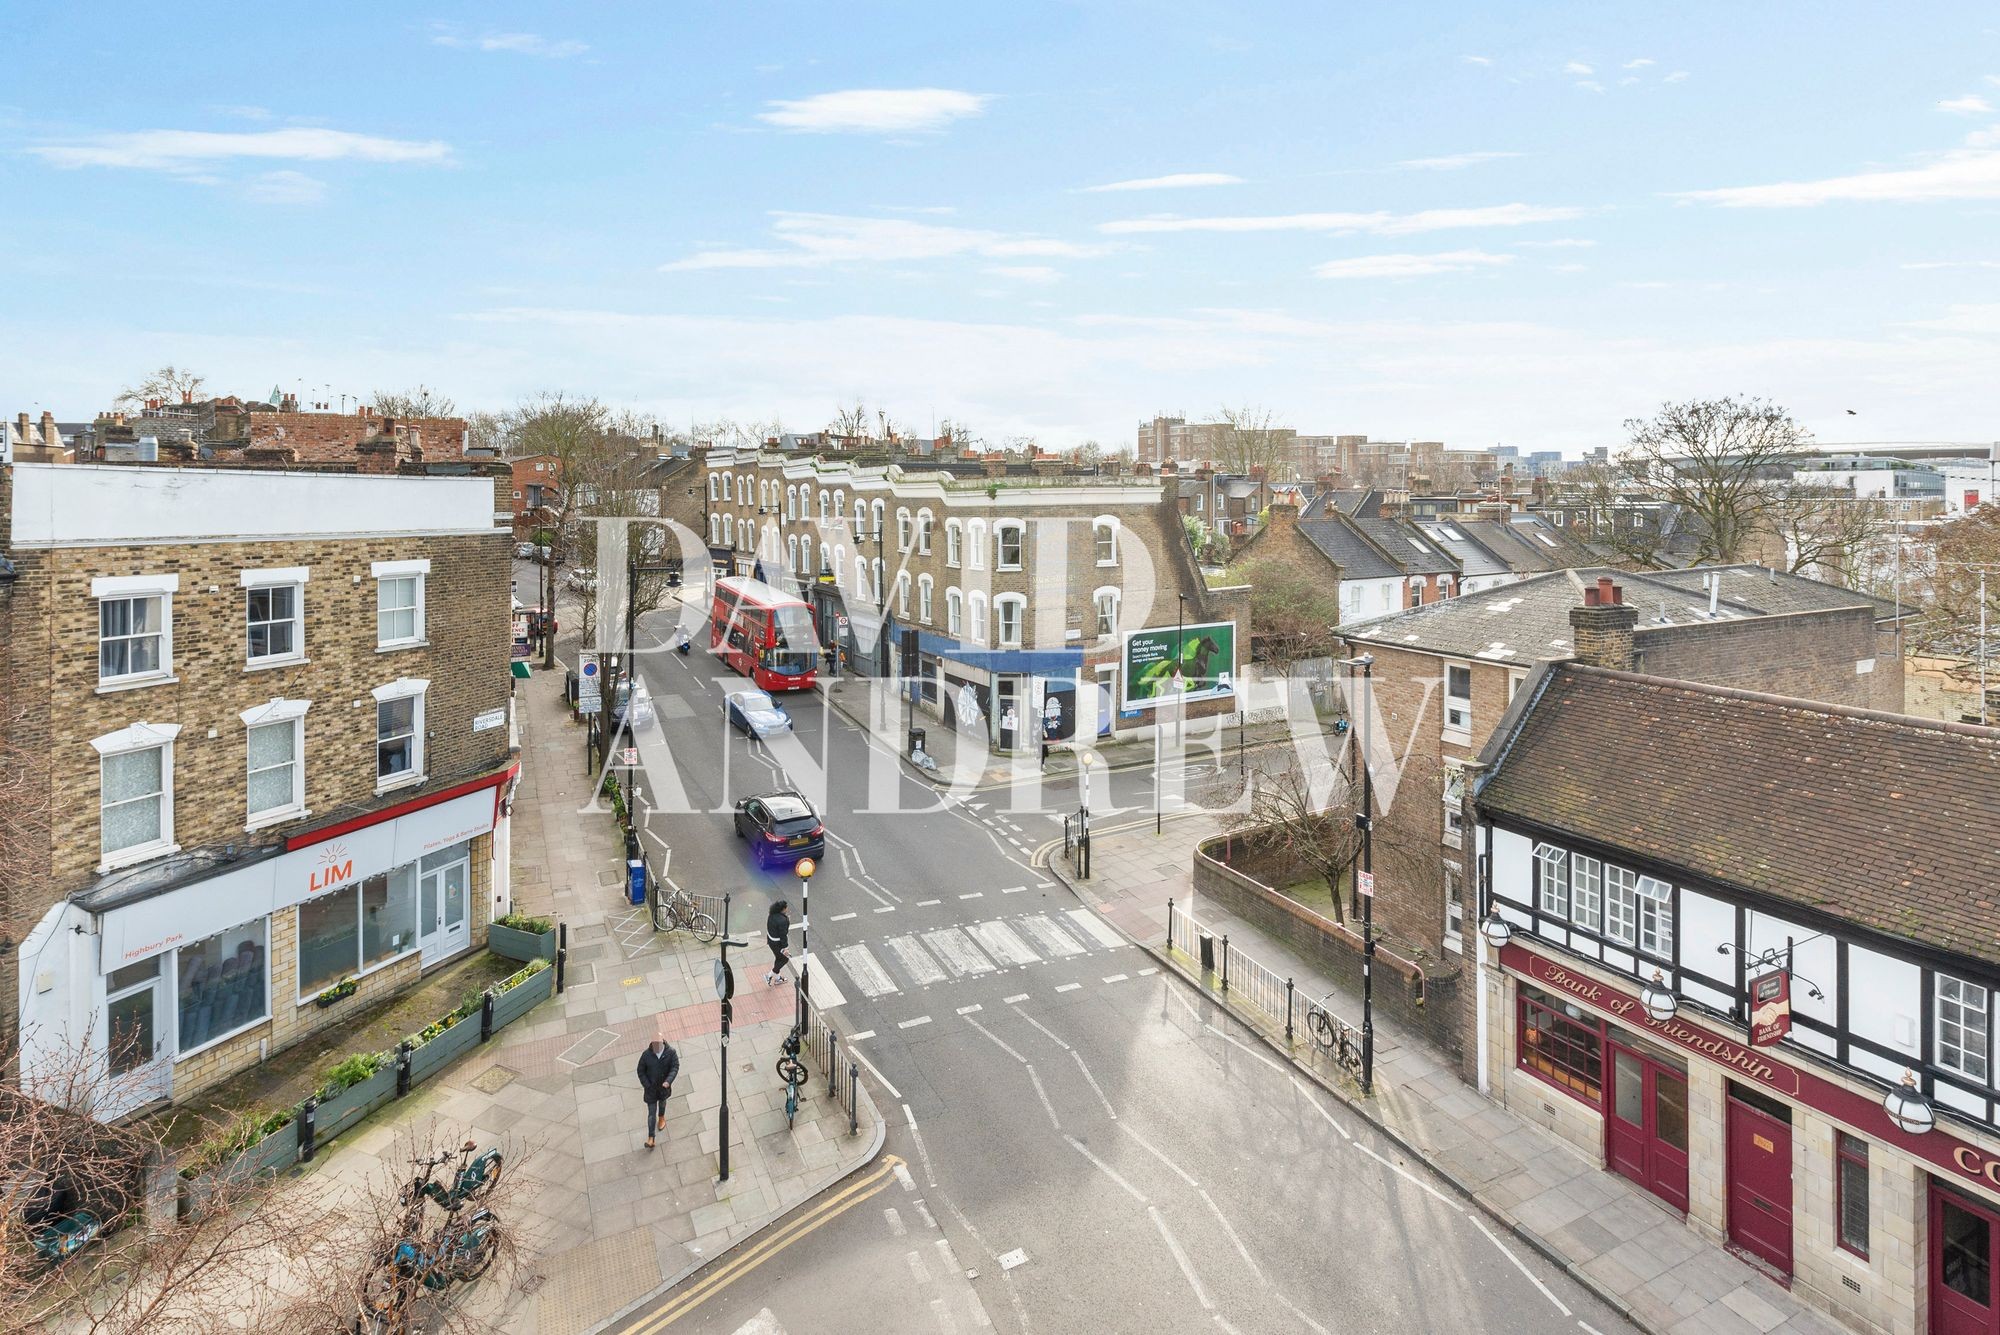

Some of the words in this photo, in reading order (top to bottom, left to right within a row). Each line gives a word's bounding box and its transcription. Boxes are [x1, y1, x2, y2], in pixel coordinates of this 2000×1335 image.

[1150, 644, 1168, 652] moving
[475, 723, 489, 731] ROAD
[310, 860, 352, 892] LIM
[124, 940, 164, 959] Highbury
[165, 933, 183, 944] Park
[1545, 966, 1602, 1001] Bank
[1610, 999, 1635, 1016] of
[1758, 1025, 1772, 1035] BANK
[1772, 1022, 1780, 1030] OF
[1757, 1029, 1783, 1043] FRIENDSHIP
